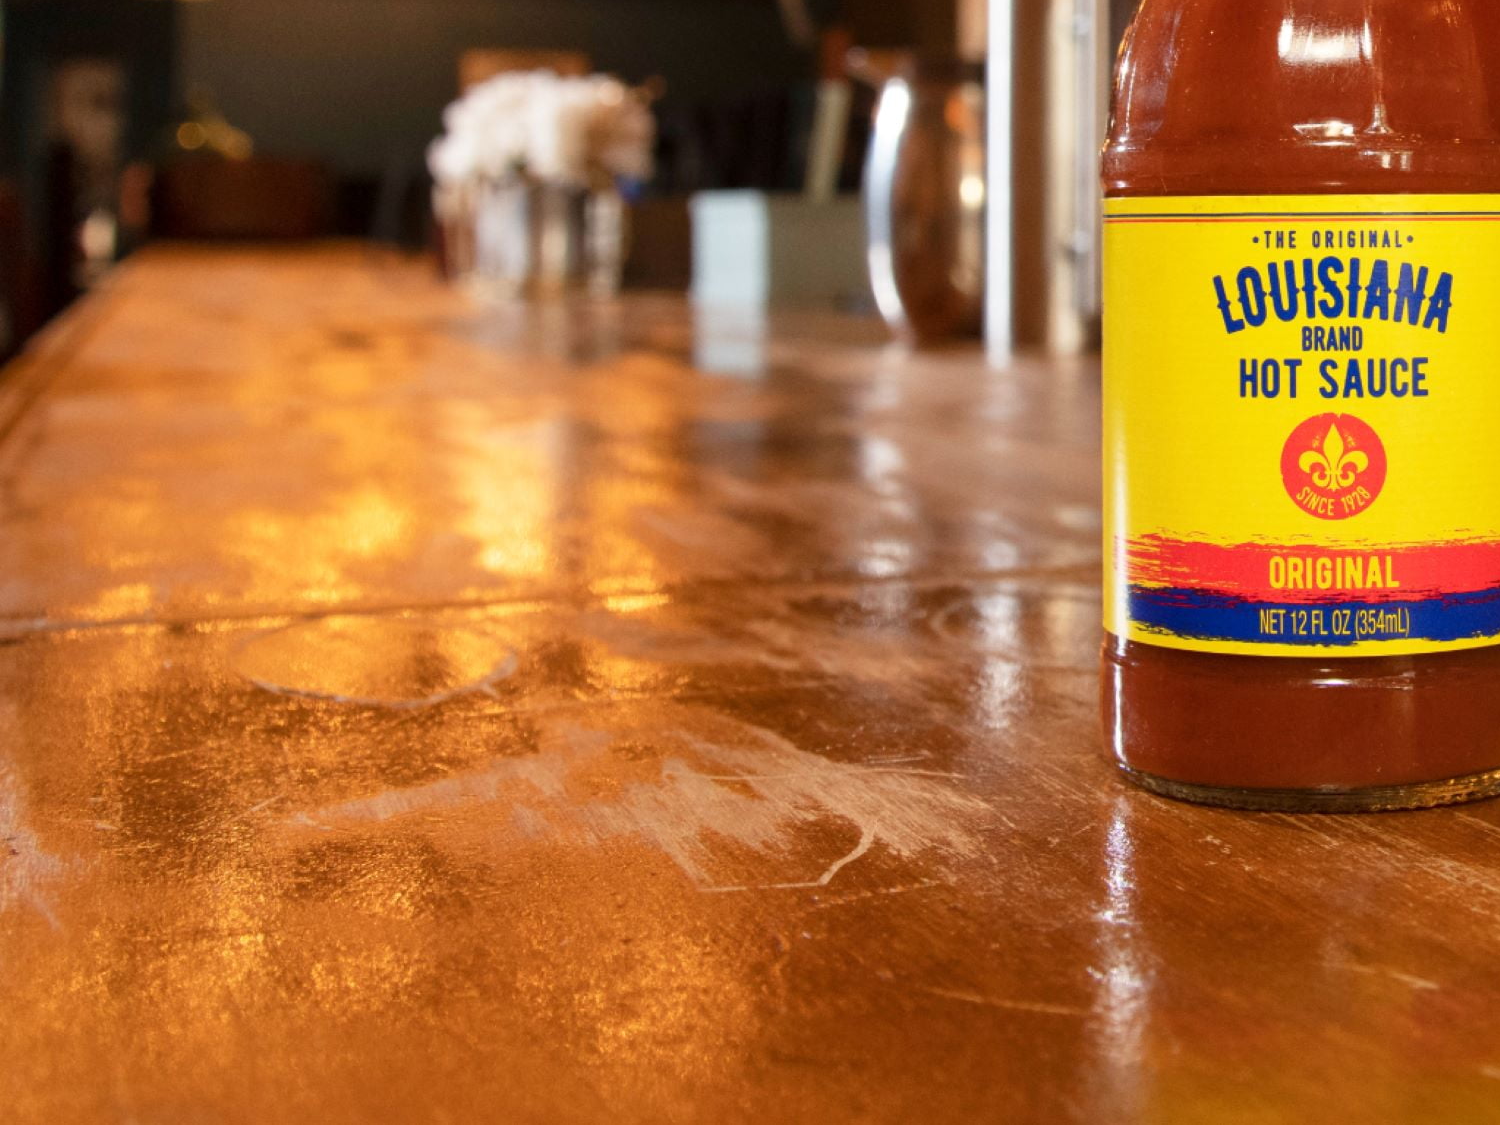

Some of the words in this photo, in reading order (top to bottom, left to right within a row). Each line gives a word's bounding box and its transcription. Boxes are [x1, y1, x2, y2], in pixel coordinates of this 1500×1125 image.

[1264, 230, 1297, 249] THE
[1311, 230, 1403, 249] ORIGINAL
[1212, 255, 1454, 335] LOUISIANA
[1301, 325, 1363, 352] BRAND
[1238, 358, 1302, 399] HOT
[1318, 357, 1429, 400] SAUCE
[1296, 485, 1335, 516] SINCE
[1341, 485, 1372, 514] 1928
[1268, 555, 1400, 590] ORIGINAL
[1260, 608, 1286, 635] NET
[1290, 609, 1307, 635] 12
[1311, 609, 1328, 635] FL
[1332, 609, 1351, 635] OZ
[1355, 607, 1410, 640] (354mL)
